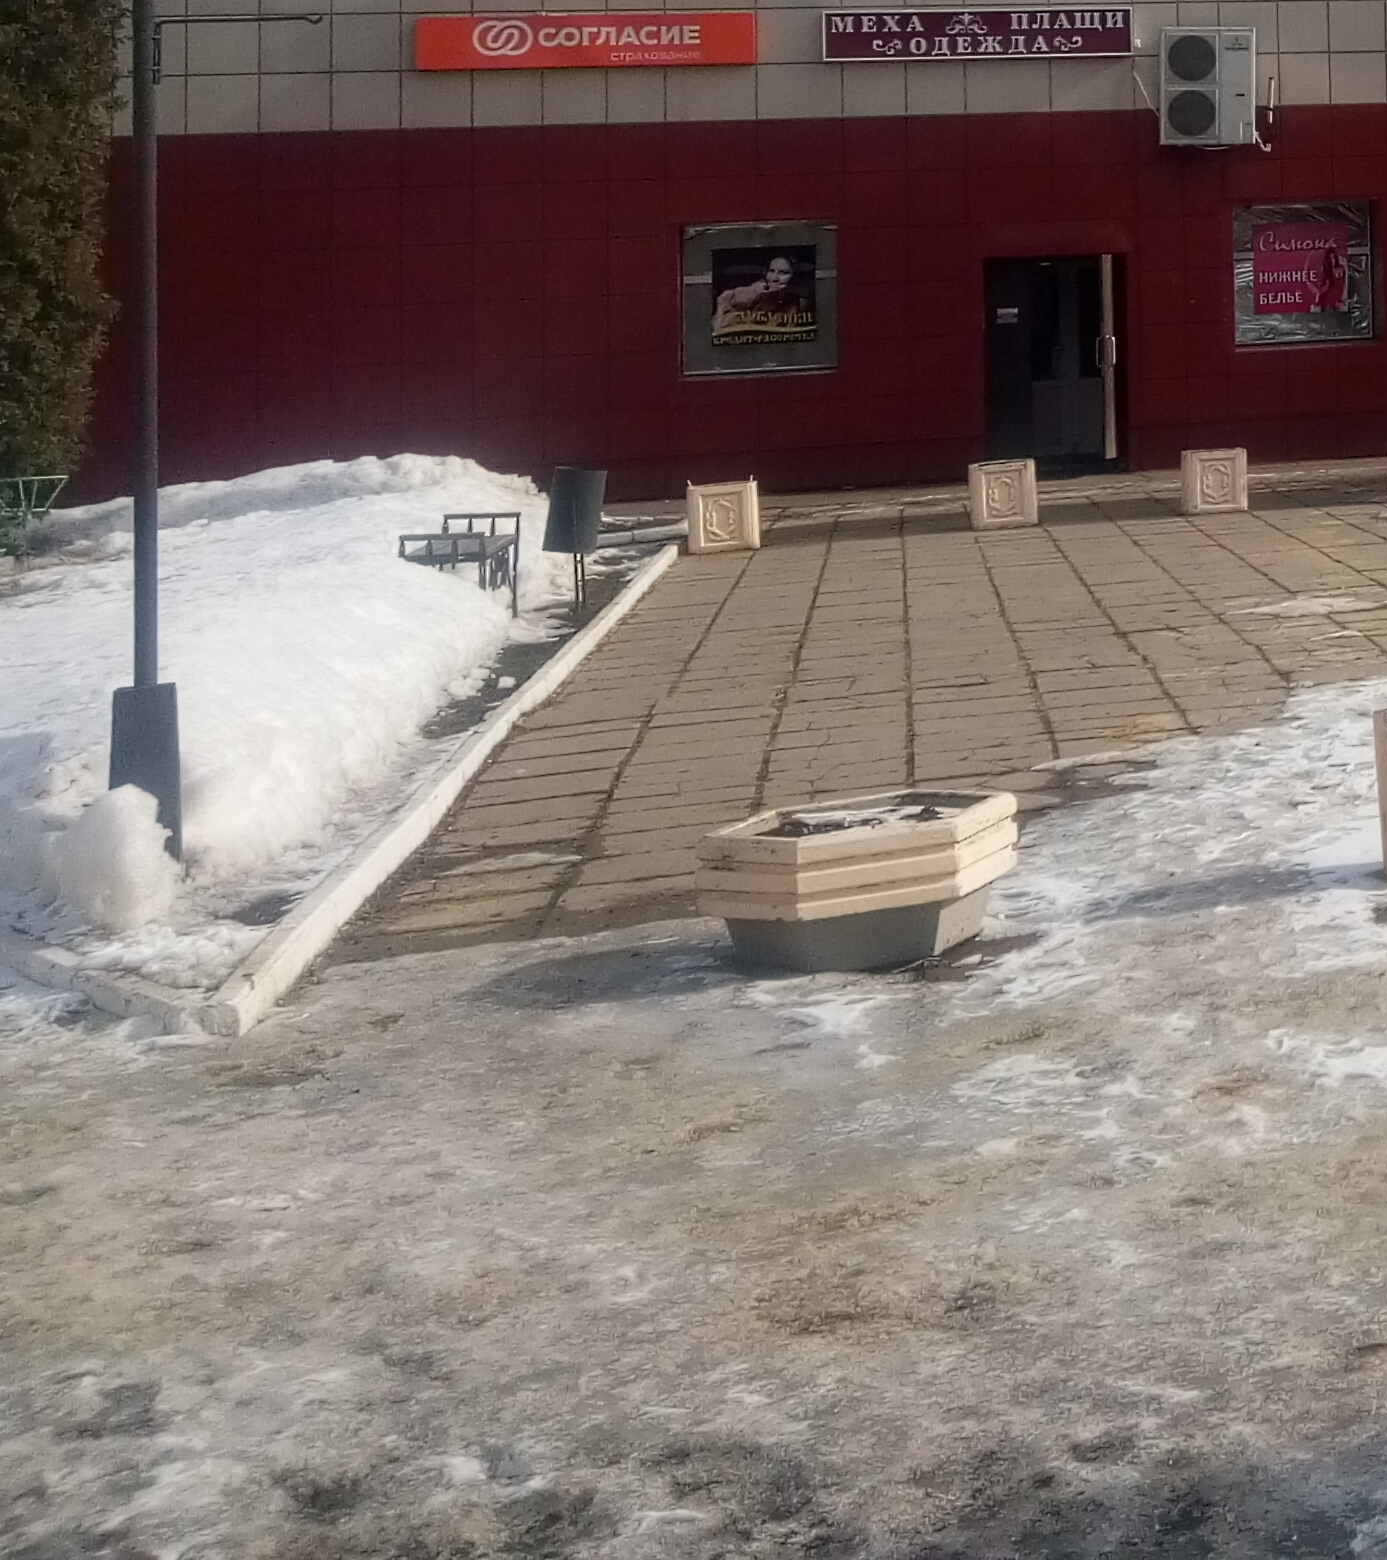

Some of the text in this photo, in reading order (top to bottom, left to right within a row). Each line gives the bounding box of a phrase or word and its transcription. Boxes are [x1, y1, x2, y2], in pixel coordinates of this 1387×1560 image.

[831, 11, 1125, 33] МЕХА ПЛАЩИ
[538, 25, 701, 47] СОГЛАСИЕ
[909, 35, 1050, 56] ОДЕЖДА
[1259, 231, 1338, 252] Симона
[1259, 270, 1318, 283] НИЖНЕЕ
[1259, 291, 1303, 305] БЕЛЬЕ
